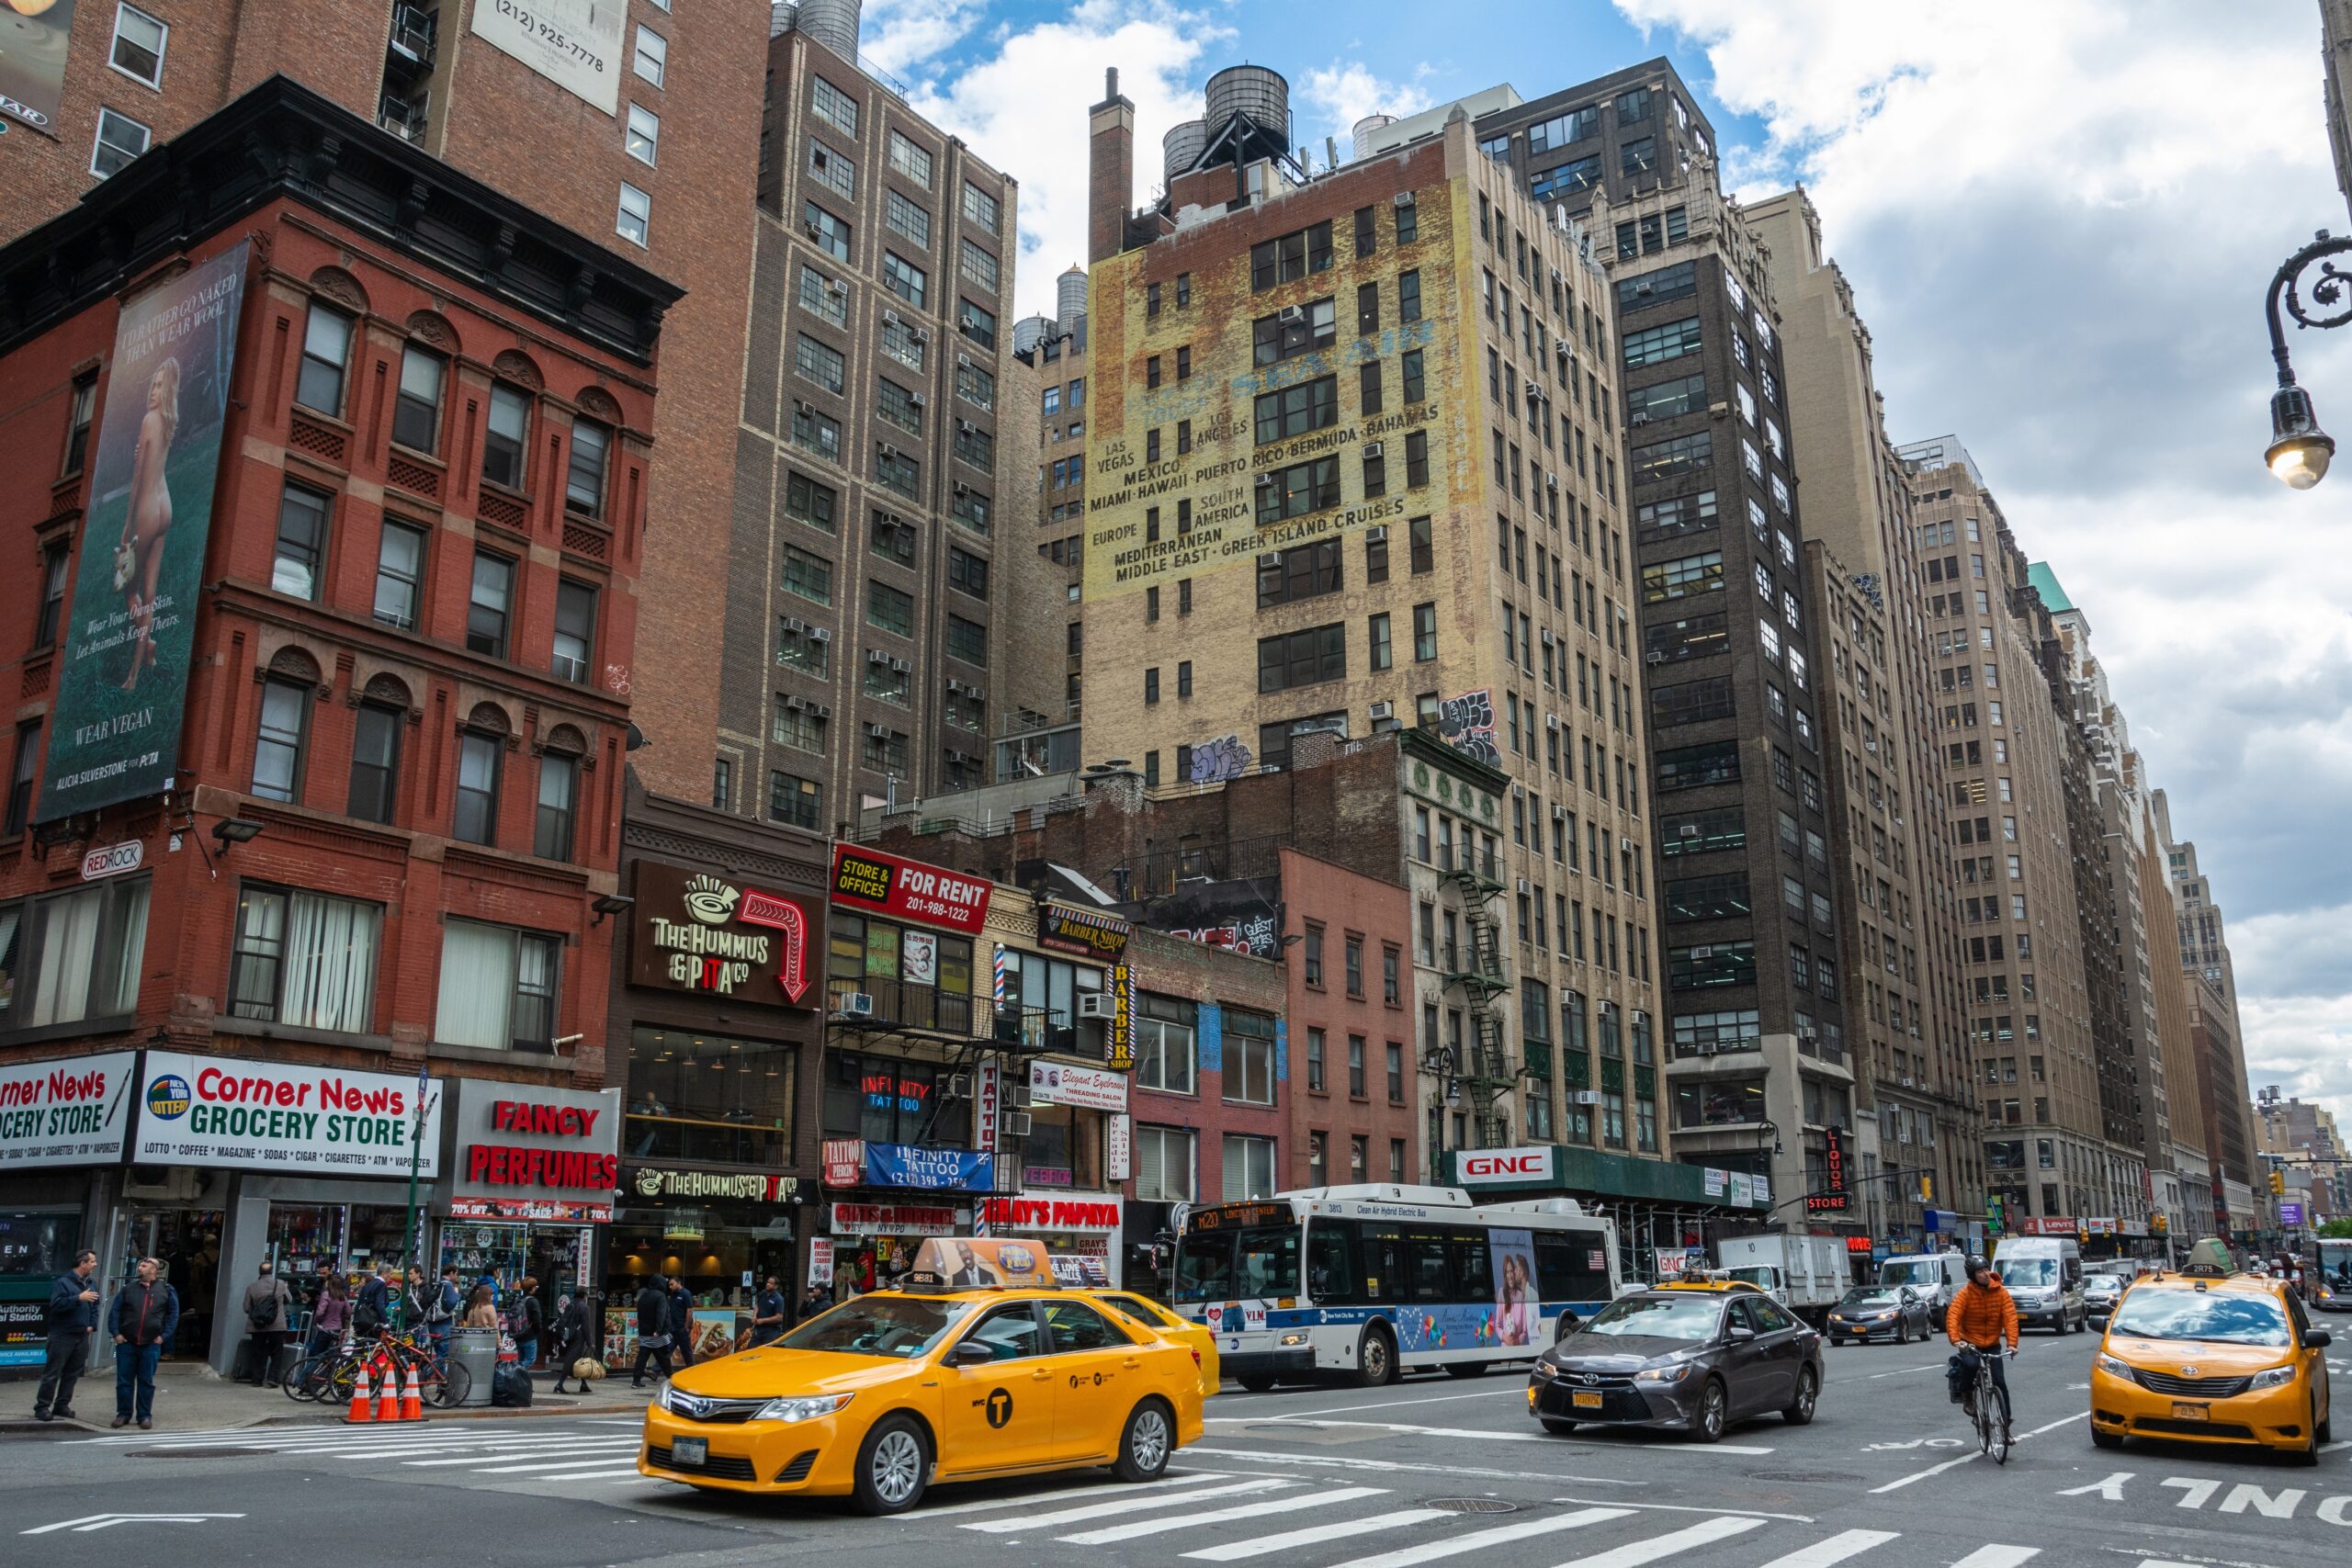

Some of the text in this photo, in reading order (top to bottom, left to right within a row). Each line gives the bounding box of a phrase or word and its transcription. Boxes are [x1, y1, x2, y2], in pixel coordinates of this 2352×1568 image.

[496, 0, 604, 73] (212) 925-7778
[138, 306, 178, 342] RATHER
[180, 296, 195, 318] GO
[198, 273, 236, 310] NAKED
[127, 298, 226, 365] THAN WEAR WOOL
[1196, 419, 1248, 448] ANGELES
[1091, 404, 1439, 513] MIAMI HAWAII PUERTO RICO BERMUDA BAHAMAS
[1105, 440, 1126, 456] LAS
[1098, 452, 1135, 474] VEGAS
[1124, 459, 1181, 487] MEXICO
[1201, 487, 1244, 510] SOUTH
[1194, 502, 1250, 529] AMERICA
[1092, 523, 1137, 547] EUROPE
[1116, 499, 1405, 582] MIDDLE EAST GREEK ISLAND CRUISES
[1114, 527, 1223, 567] MEDITERRANEAN
[87, 595, 174, 636] Wear Your Own Skin.
[76, 613, 180, 660] Let Animals Keep Theirs.
[75, 706, 154, 747] WEAR VEGAN
[56, 773, 79, 791] ALICIA
[80, 760, 128, 784] SILVERSTONE
[87, 846, 138, 873] REDROCK
[842, 860, 888, 883] STORE &
[840, 875, 885, 897] OFFICES
[899, 868, 985, 907] FOR RENT
[906, 897, 969, 922] 201-988-1222
[650, 918, 768, 964] THE HUMMUS
[1060, 919, 1098, 942] BARBER
[1101, 930, 1126, 949] SHOP
[685, 955, 732, 994] PITA
[1114, 966, 1128, 1059] BARBER
[1110, 1060, 1133, 1069] SHOP
[48, 1068, 106, 1103] News
[169, 1079, 185, 1089] NEW
[197, 1067, 405, 1115] Corner News
[862, 1076, 930, 1100] INFINITY
[1062, 1069, 1125, 1091] Elegant Eyebrows
[171, 1089, 189, 1100] YORK
[869, 1094, 920, 1111] TATTOO
[1066, 1088, 1122, 1101] THREADING SALON
[150, 1100, 189, 1115] LOTTERY
[493, 1100, 601, 1136] FANCY
[48, 1103, 104, 1136] STORE
[190, 1104, 405, 1146] GROCERY STORE
[144, 1143, 431, 1168] LOTTO COFFEE MAGAZINE SODAS CIGAR CIGARETTES ATM VAPOZER
[828, 1140, 859, 1164] TATTOO
[896, 1146, 961, 1164] INFINITY
[1827, 1131, 1842, 1190] LIQUOR
[467, 1145, 618, 1190] PERFUMES
[902, 1158, 959, 1176] TATTOO
[1466, 1156, 1544, 1176] GNC
[663, 1171, 689, 1194] THE
[689, 1172, 745, 1199] HUMMUS
[754, 1175, 786, 1202] PITA
[922, 1175, 937, 1186] 398
[452, 1203, 488, 1214] 70% OFF
[529, 1208, 552, 1219] SALE
[984, 1198, 1120, 1226] GRAY'S PAPAYA
[1329, 1204, 1342, 1213] 3813
[1357, 1205, 1372, 1213] Clean
[1381, 1207, 1397, 1216] Hybrid
[1398, 1208, 1417, 1216] Electric
[1808, 1197, 1846, 1209] STORE
[591, 1210, 607, 1220] 70%
[1198, 1211, 1219, 1228] M20
[814, 1241, 833, 1250] MONEY
[1079, 1247, 1108, 1257] PAPAYA
[1080, 1239, 1107, 1248] GRAY'S
[1748, 1243, 1756, 1253] 10
[580, 1232, 590, 1285] PERFUMES
[1062, 1264, 1080, 1272] LOVE
[1660, 1257, 1685, 1271] GNC
[2194, 1265, 2213, 1273] 2R75
[744, 1274, 751, 1282] A
[913, 1273, 934, 1283] 9B81
[0, 1304, 40, 1317] Authority
[9, 1313, 43, 1322] Station
[972, 1399, 985, 1407] NYC
